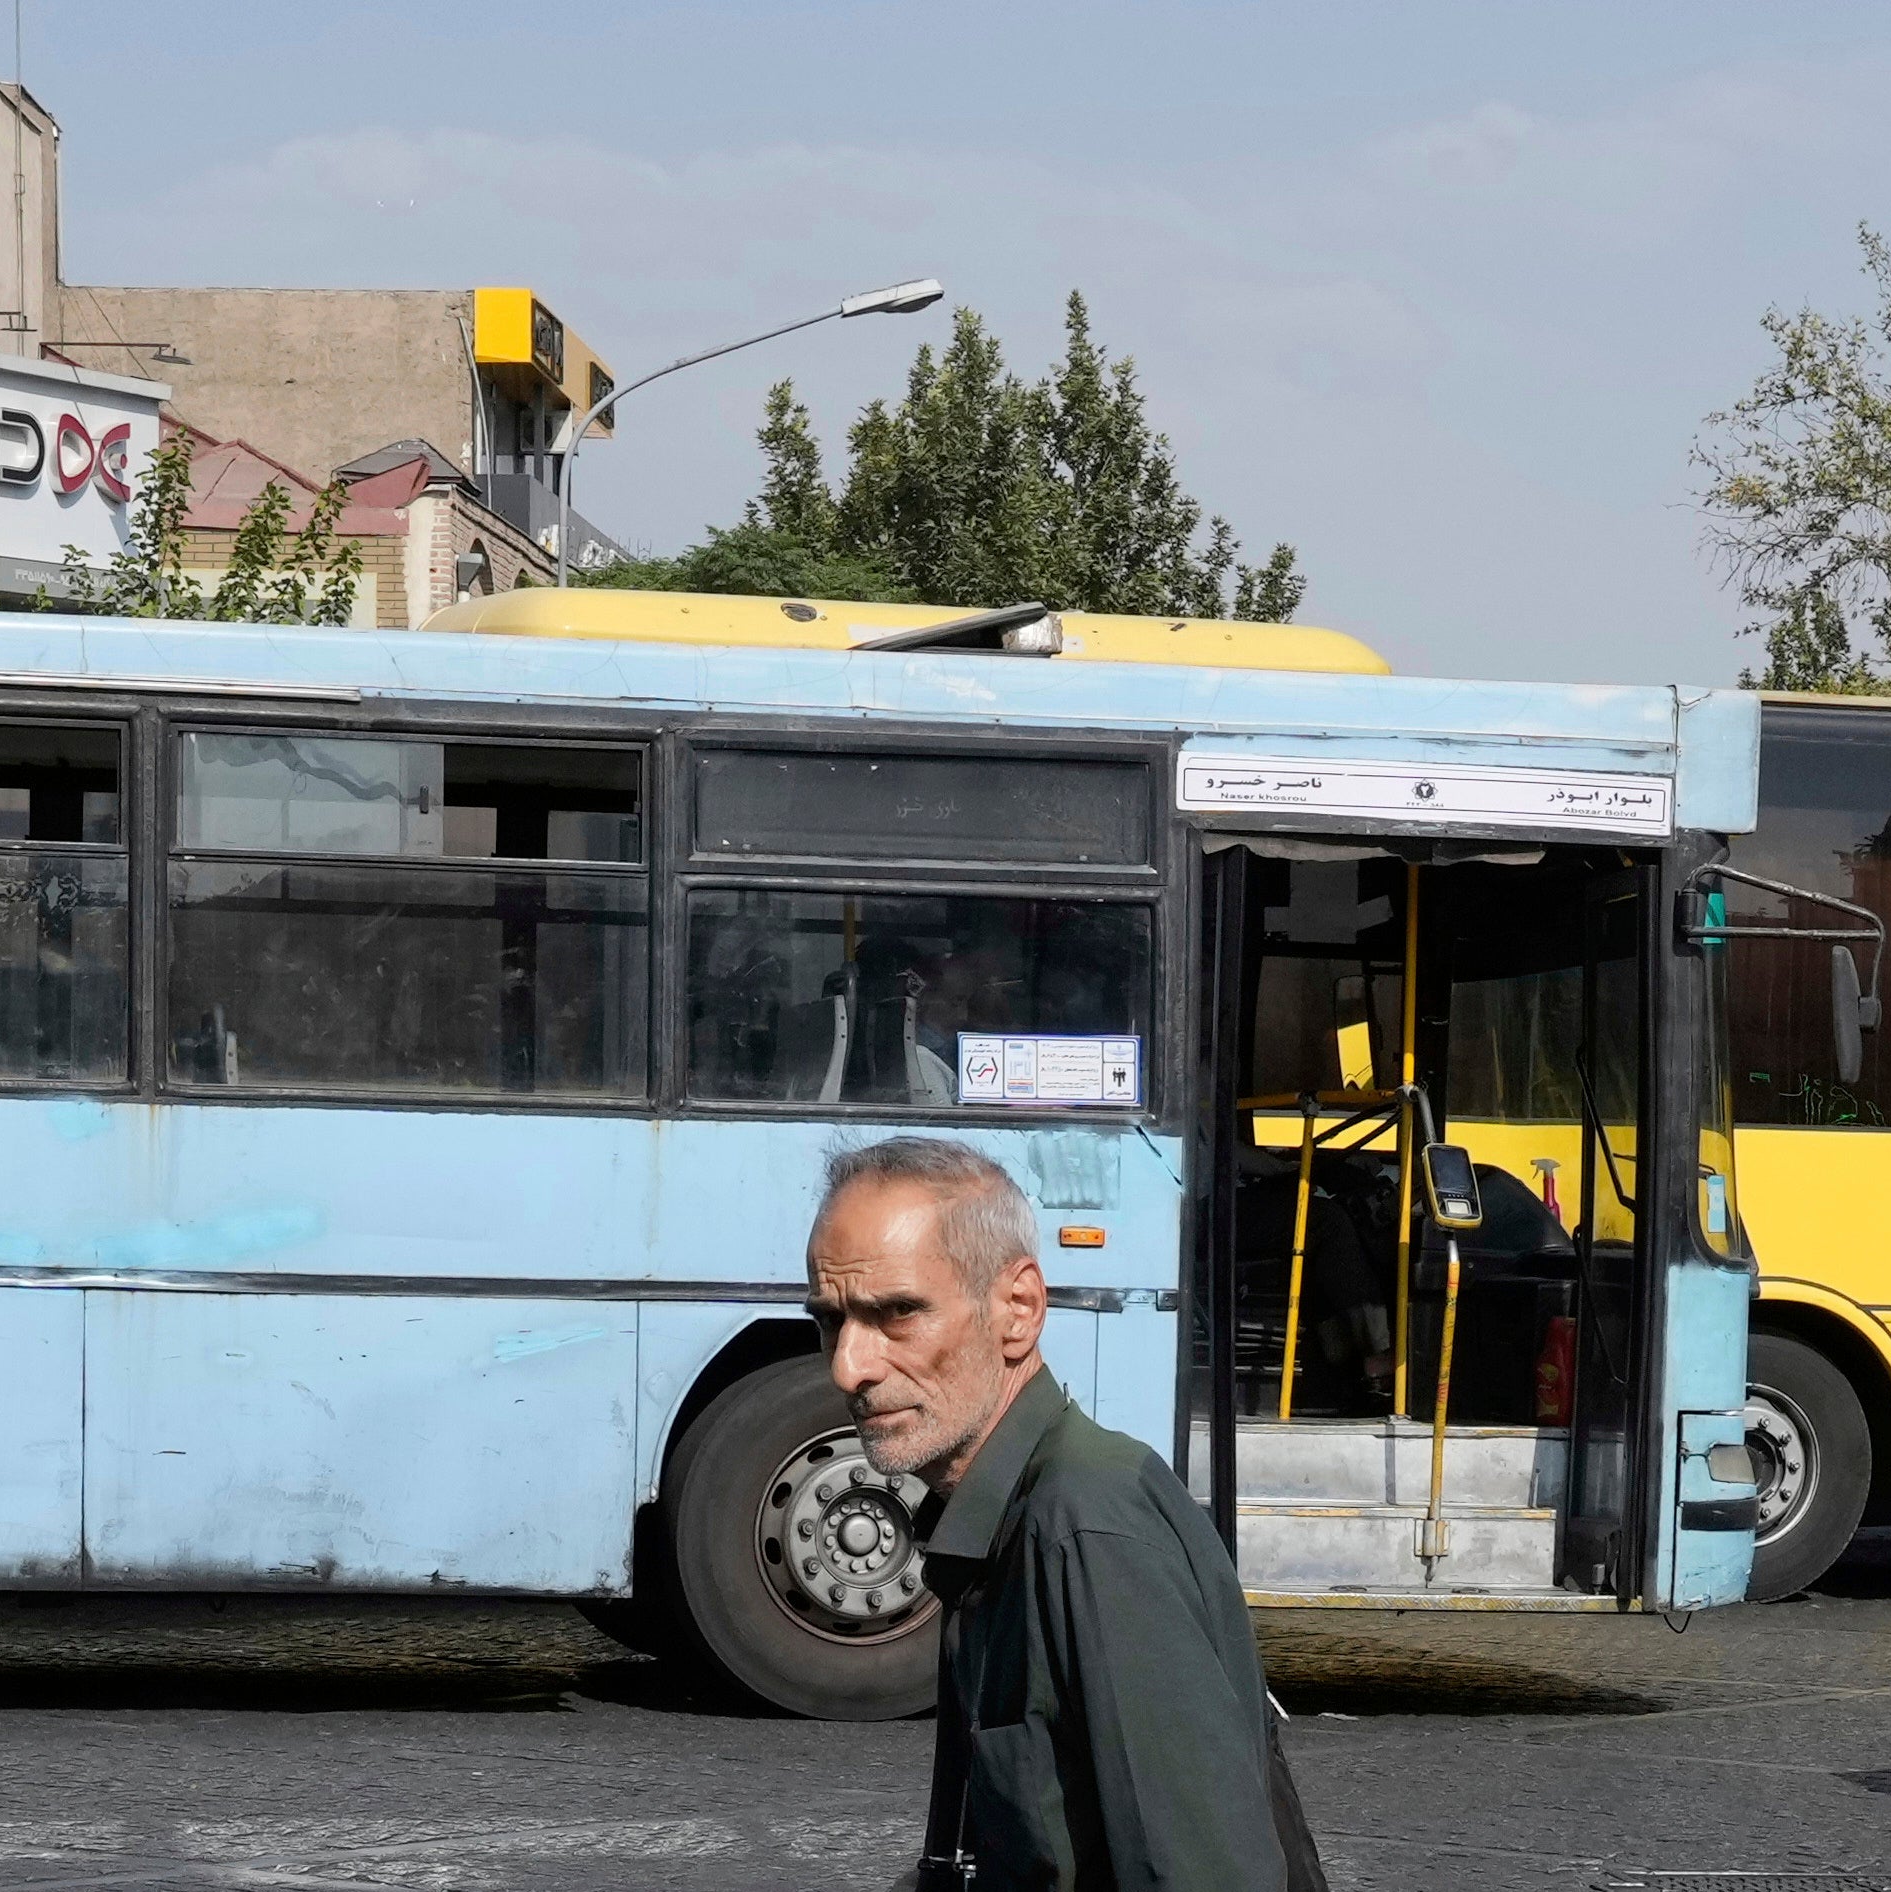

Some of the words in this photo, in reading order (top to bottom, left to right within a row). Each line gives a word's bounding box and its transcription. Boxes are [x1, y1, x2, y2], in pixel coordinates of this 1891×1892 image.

[1205, 775, 1266, 791] خسرو
[1273, 776, 1323, 791] ناصر
[1220, 792, 1255, 802] Naser
[1258, 793, 1308, 803] khosrou
[1546, 788, 1600, 804] ابوذر
[1604, 791, 1654, 807] بلوار
[1562, 806, 1602, 815] Abozar
